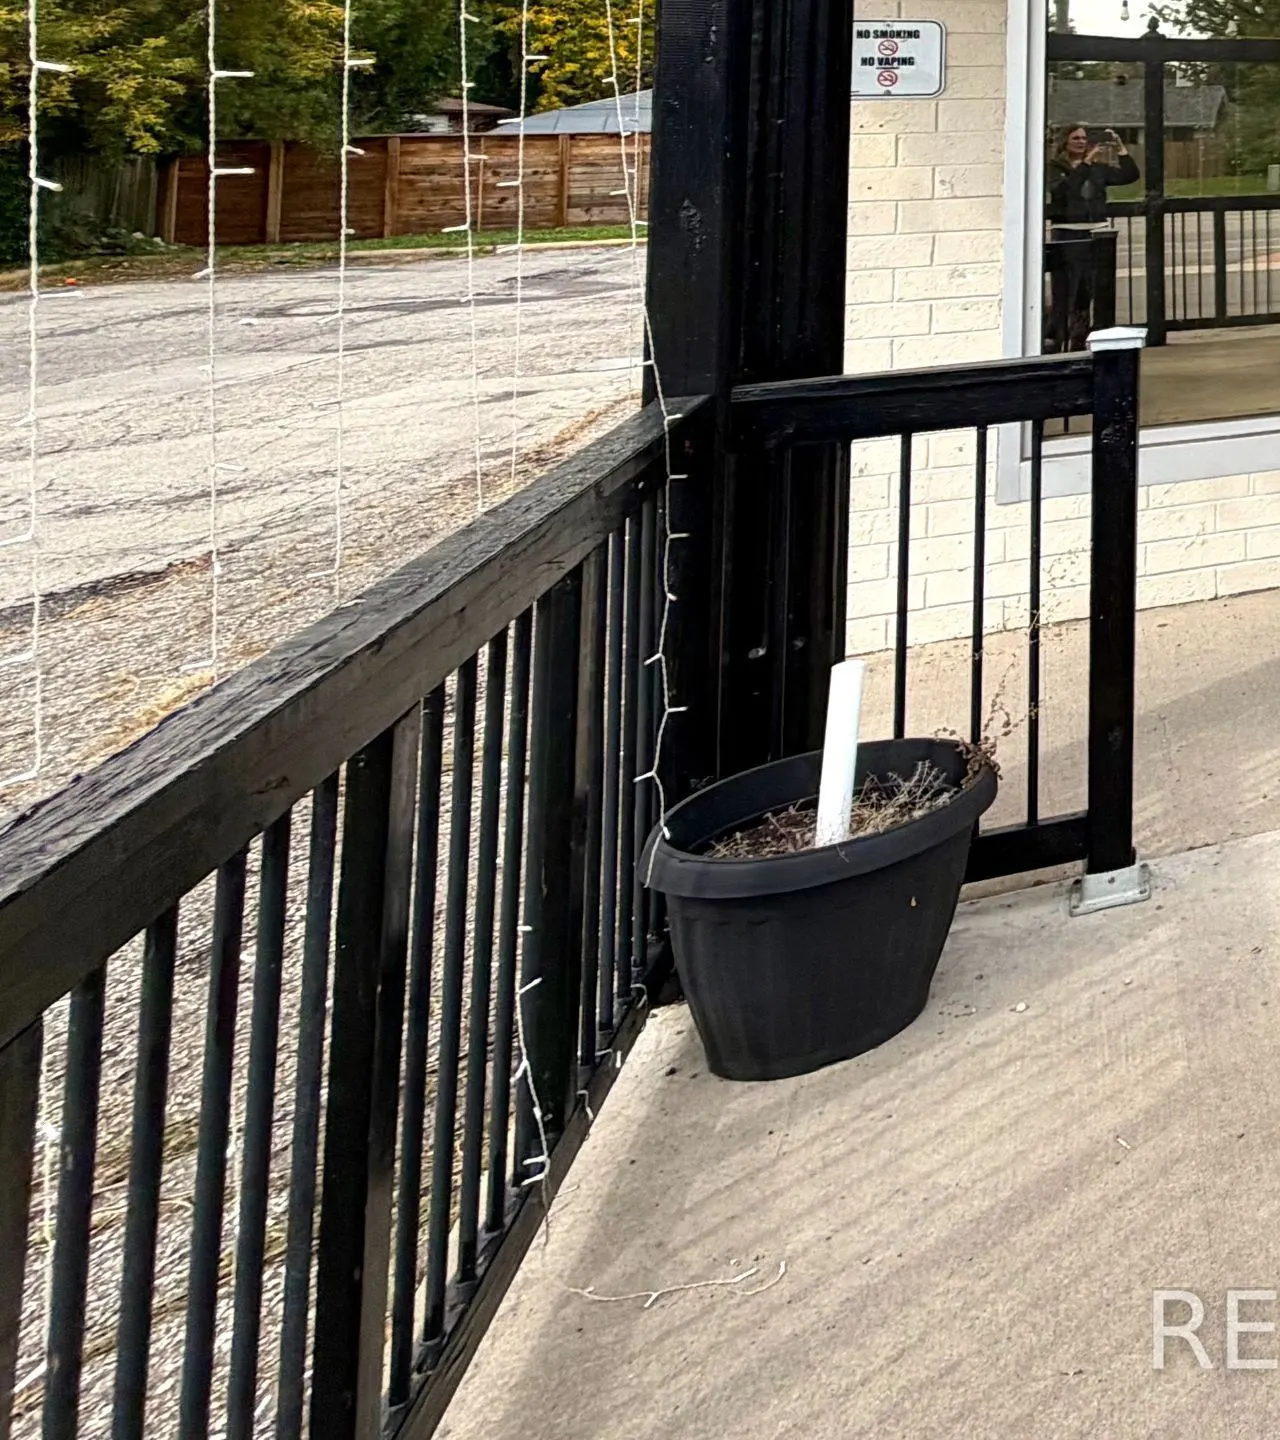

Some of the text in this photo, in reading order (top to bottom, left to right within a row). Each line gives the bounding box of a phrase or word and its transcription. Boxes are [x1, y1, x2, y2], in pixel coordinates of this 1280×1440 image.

[856, 29, 921, 39] NO SMOKING
[860, 56, 915, 67] NO VAPING
